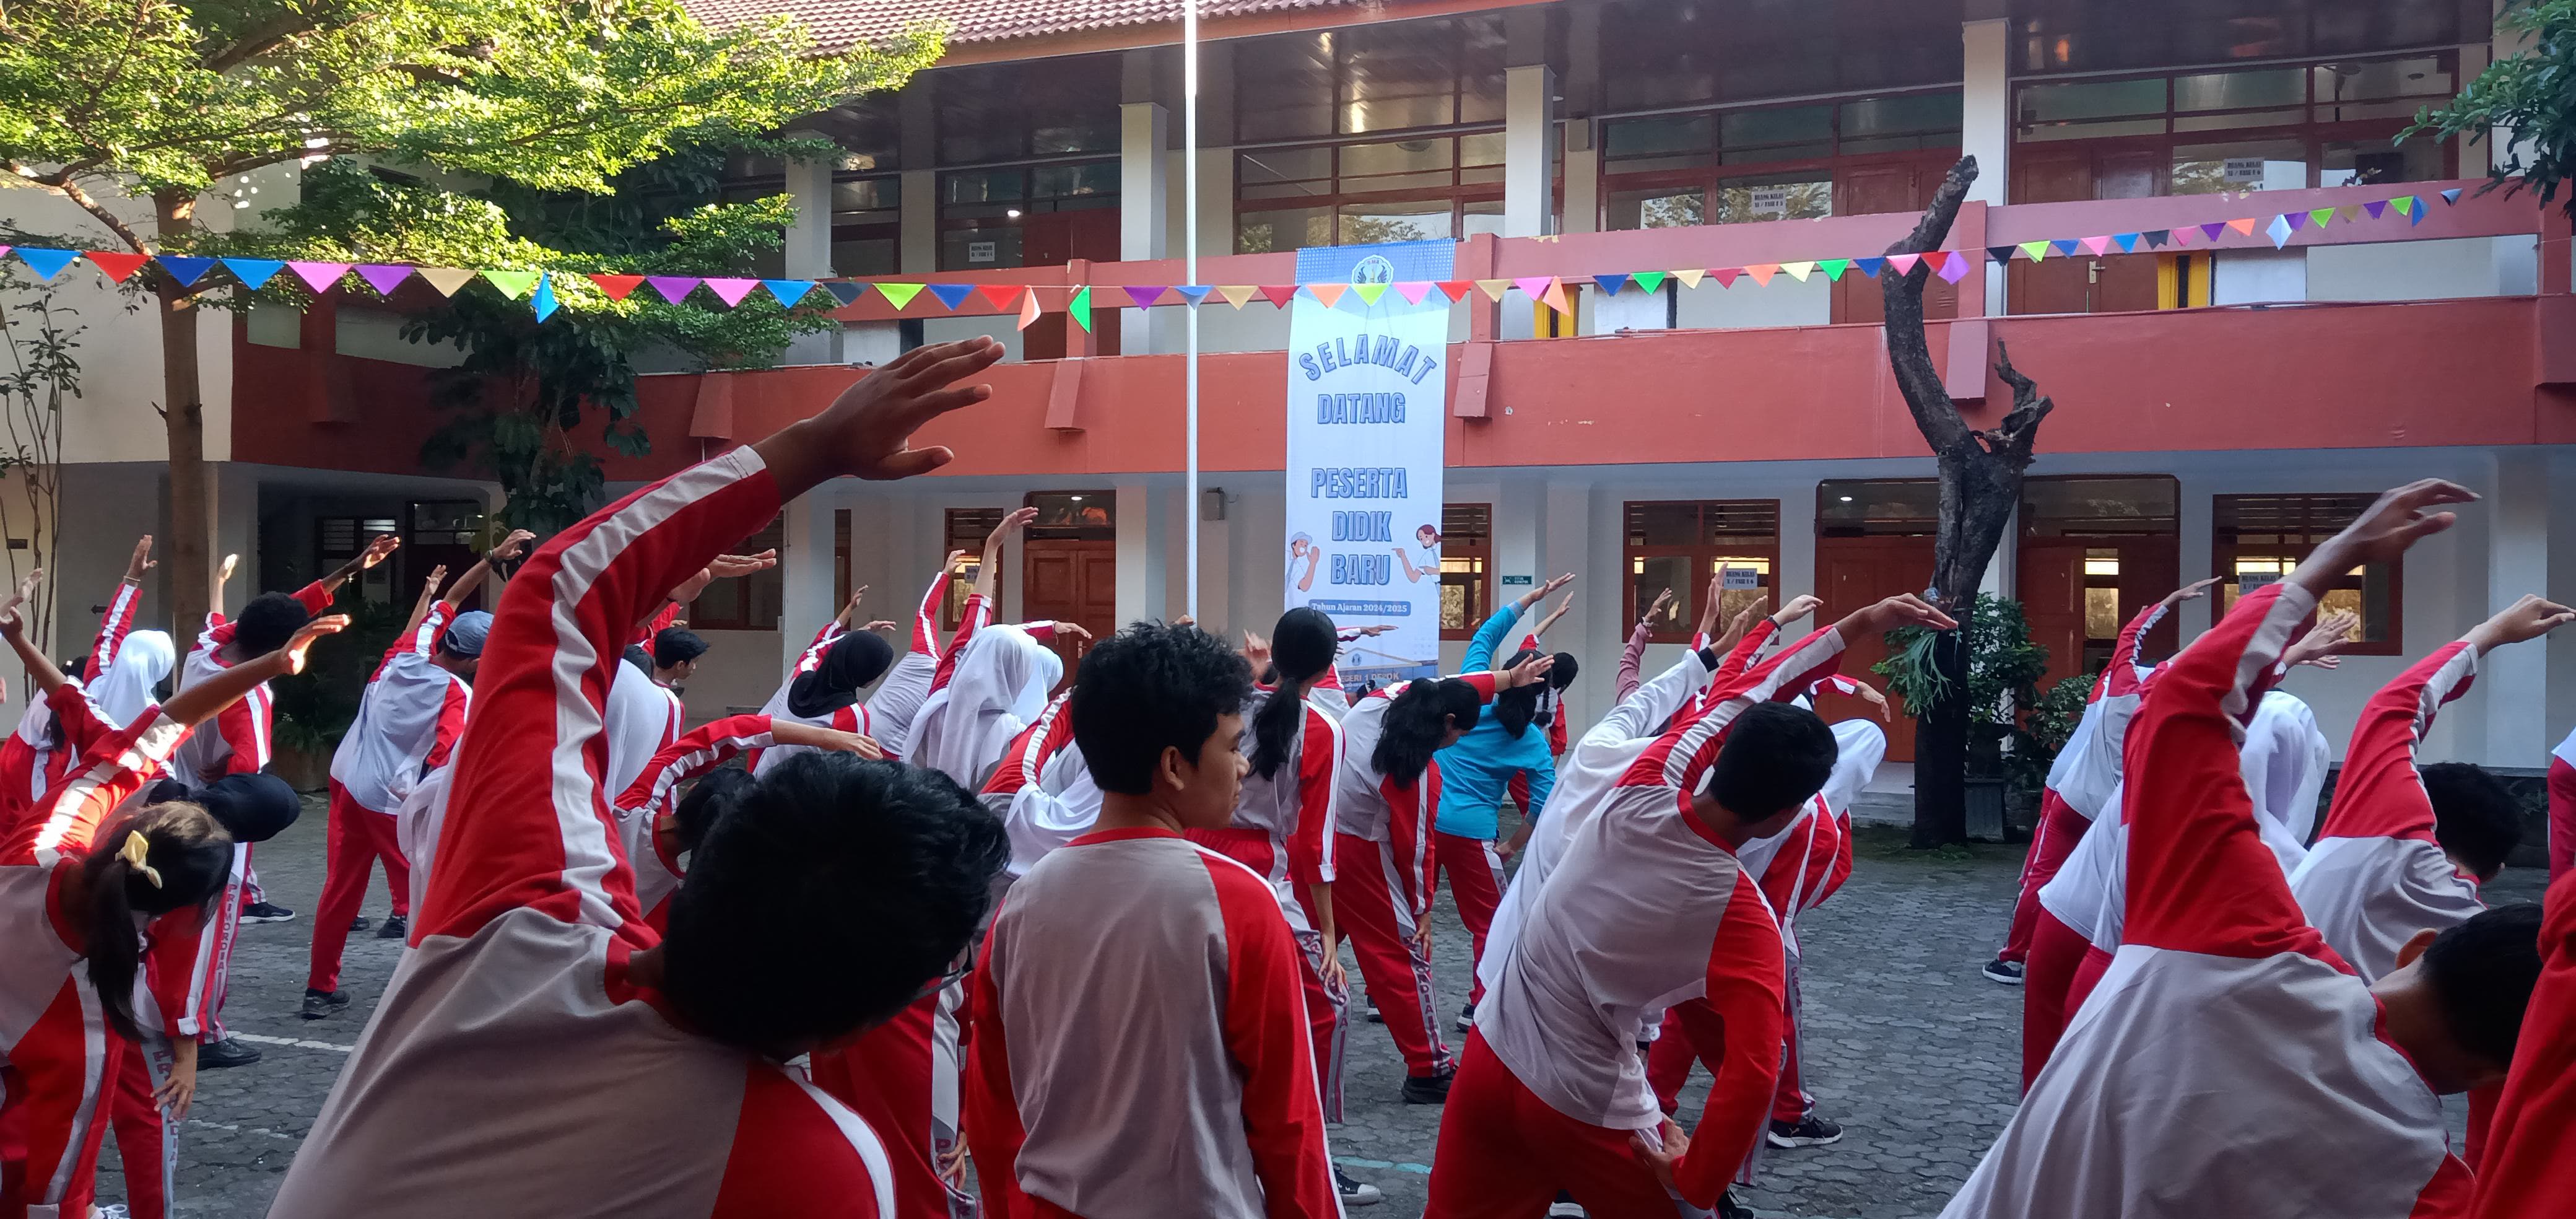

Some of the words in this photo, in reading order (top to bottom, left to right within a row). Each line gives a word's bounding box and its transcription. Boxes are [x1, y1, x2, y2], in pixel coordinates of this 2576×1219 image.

[1299, 333, 1437, 385] SELAMAT
[1317, 391, 1406, 424] DATANG
[1311, 467, 1408, 499] PESERTA
[1331, 510, 1393, 542] DIDIK
[1330, 553, 1391, 585] BARU
[1311, 602, 1336, 611] Tahun
[1337, 603, 1362, 613] Ajaran
[1363, 604, 1408, 613] 2024/2025
[1341, 674, 1362, 683] EGERI
[1364, 673, 1369, 681] 1
